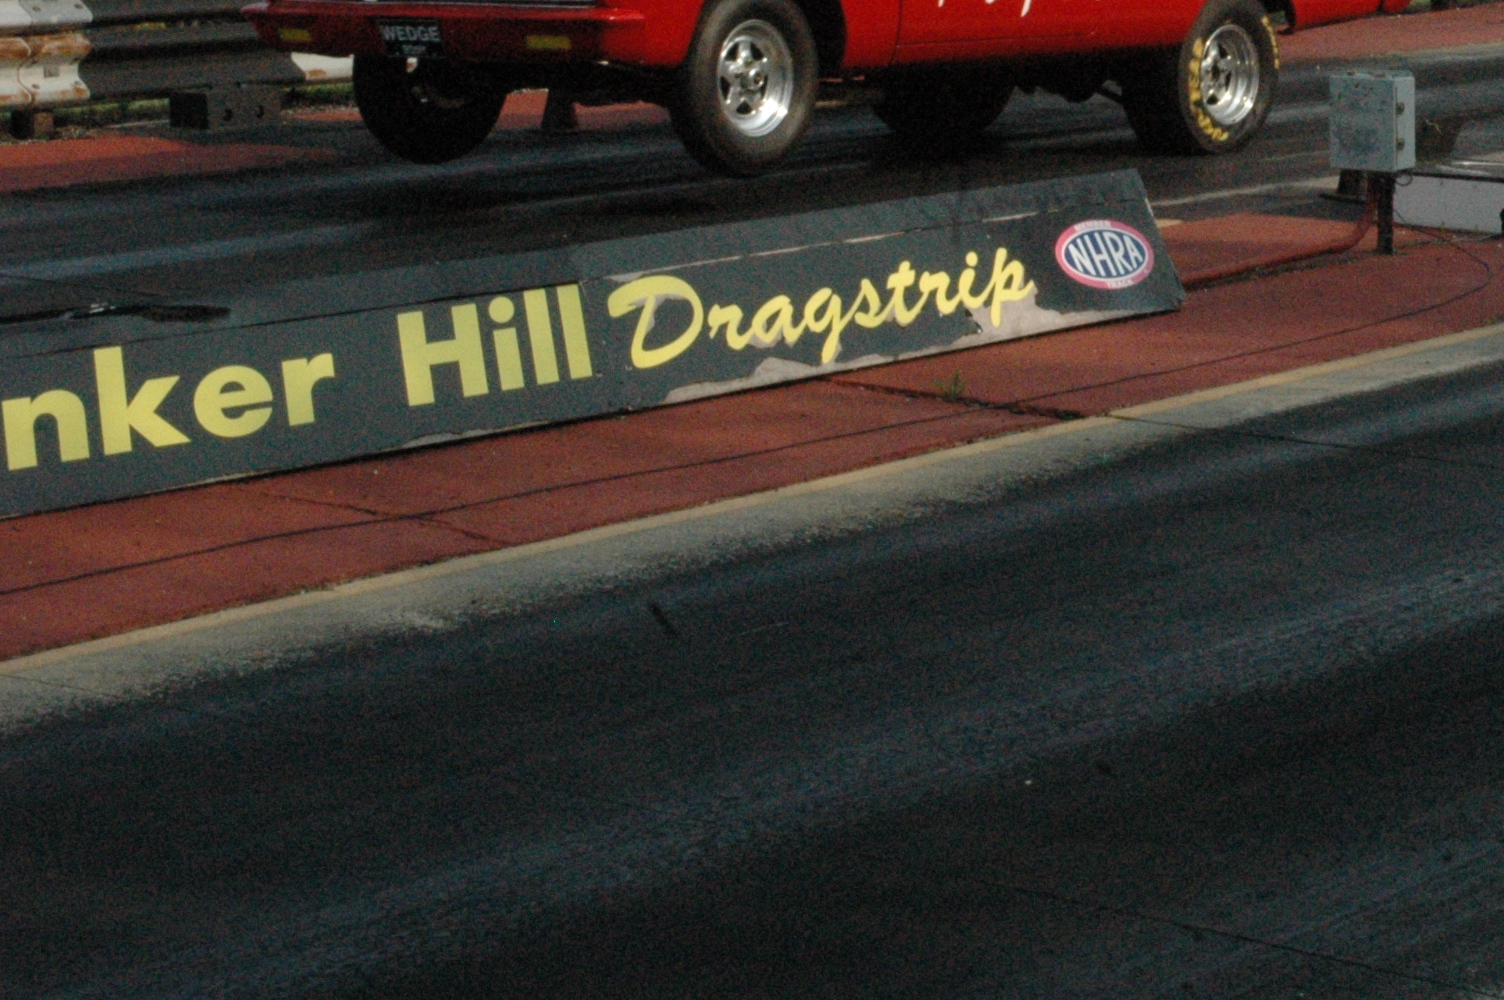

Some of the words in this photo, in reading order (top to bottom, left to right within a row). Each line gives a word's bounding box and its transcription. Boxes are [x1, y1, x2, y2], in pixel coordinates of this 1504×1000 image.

[380, 25, 441, 42] WEDGE
[1067, 231, 1144, 277] NHRA
[397, 283, 593, 408] Hill
[608, 247, 1036, 370] Dragstrip
